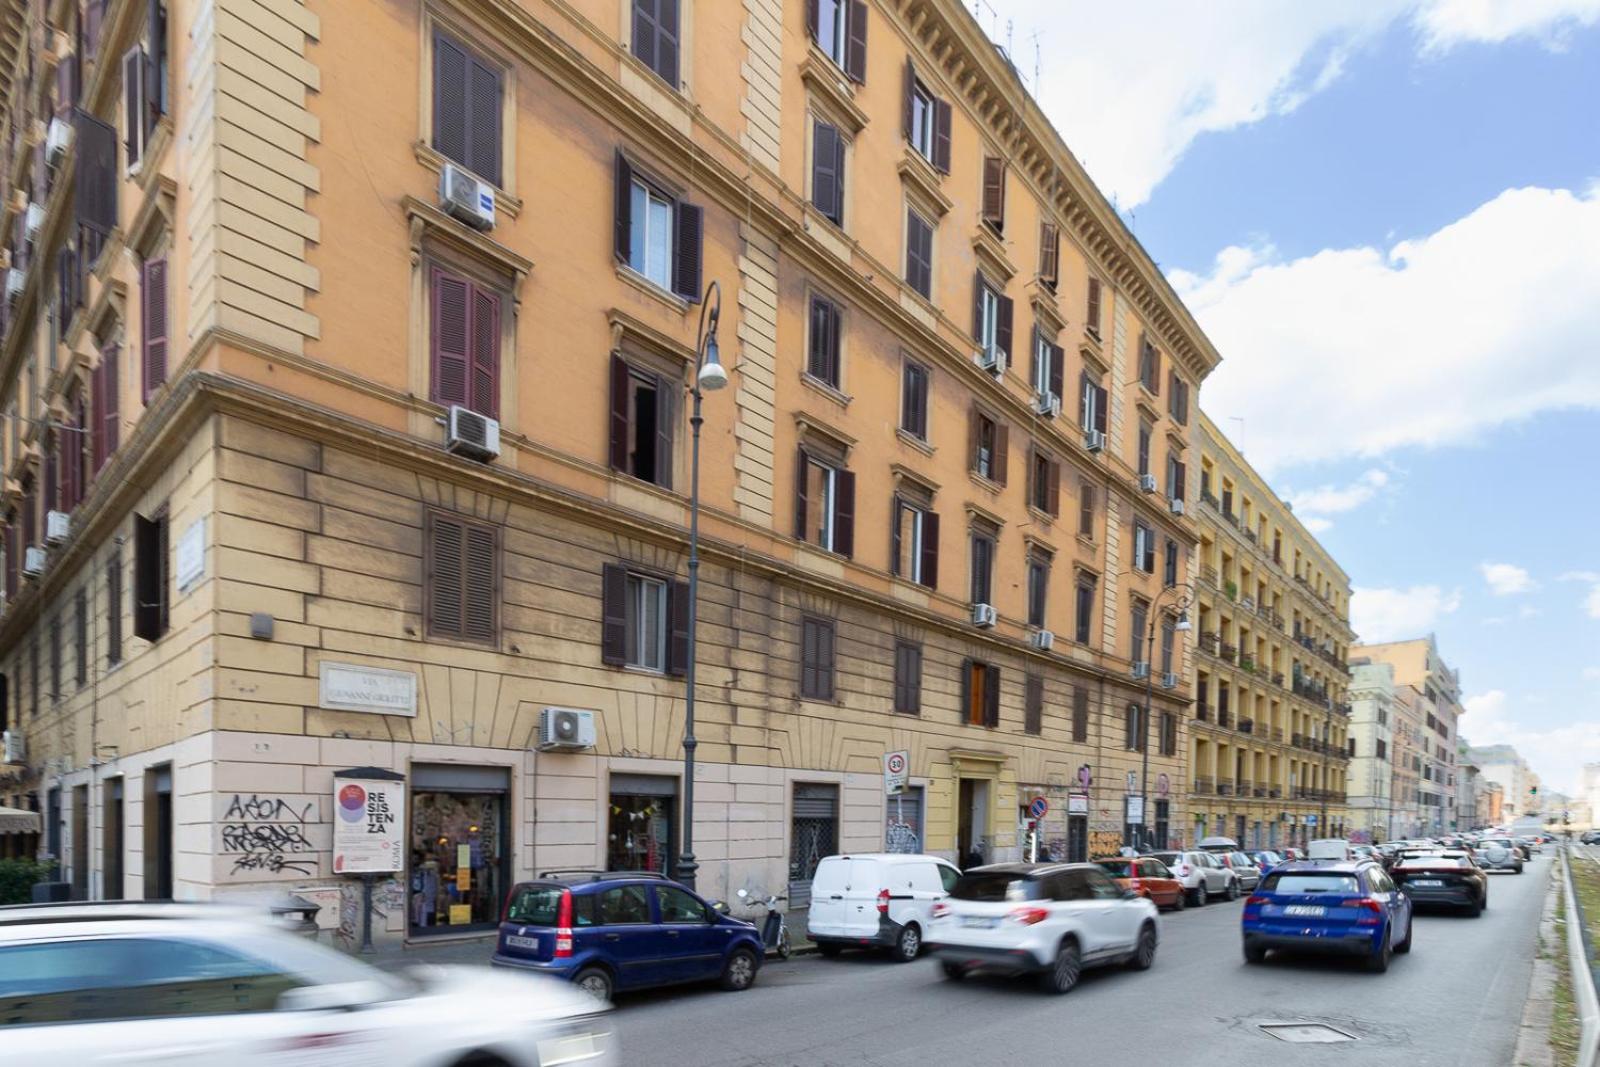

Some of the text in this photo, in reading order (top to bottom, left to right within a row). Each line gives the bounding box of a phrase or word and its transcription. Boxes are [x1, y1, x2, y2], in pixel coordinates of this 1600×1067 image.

[892, 760, 901, 769] 30
[368, 792, 385, 802] RE
[367, 803, 389, 813] SIS
[367, 813, 395, 823] TEN
[367, 823, 386, 834] ZA
